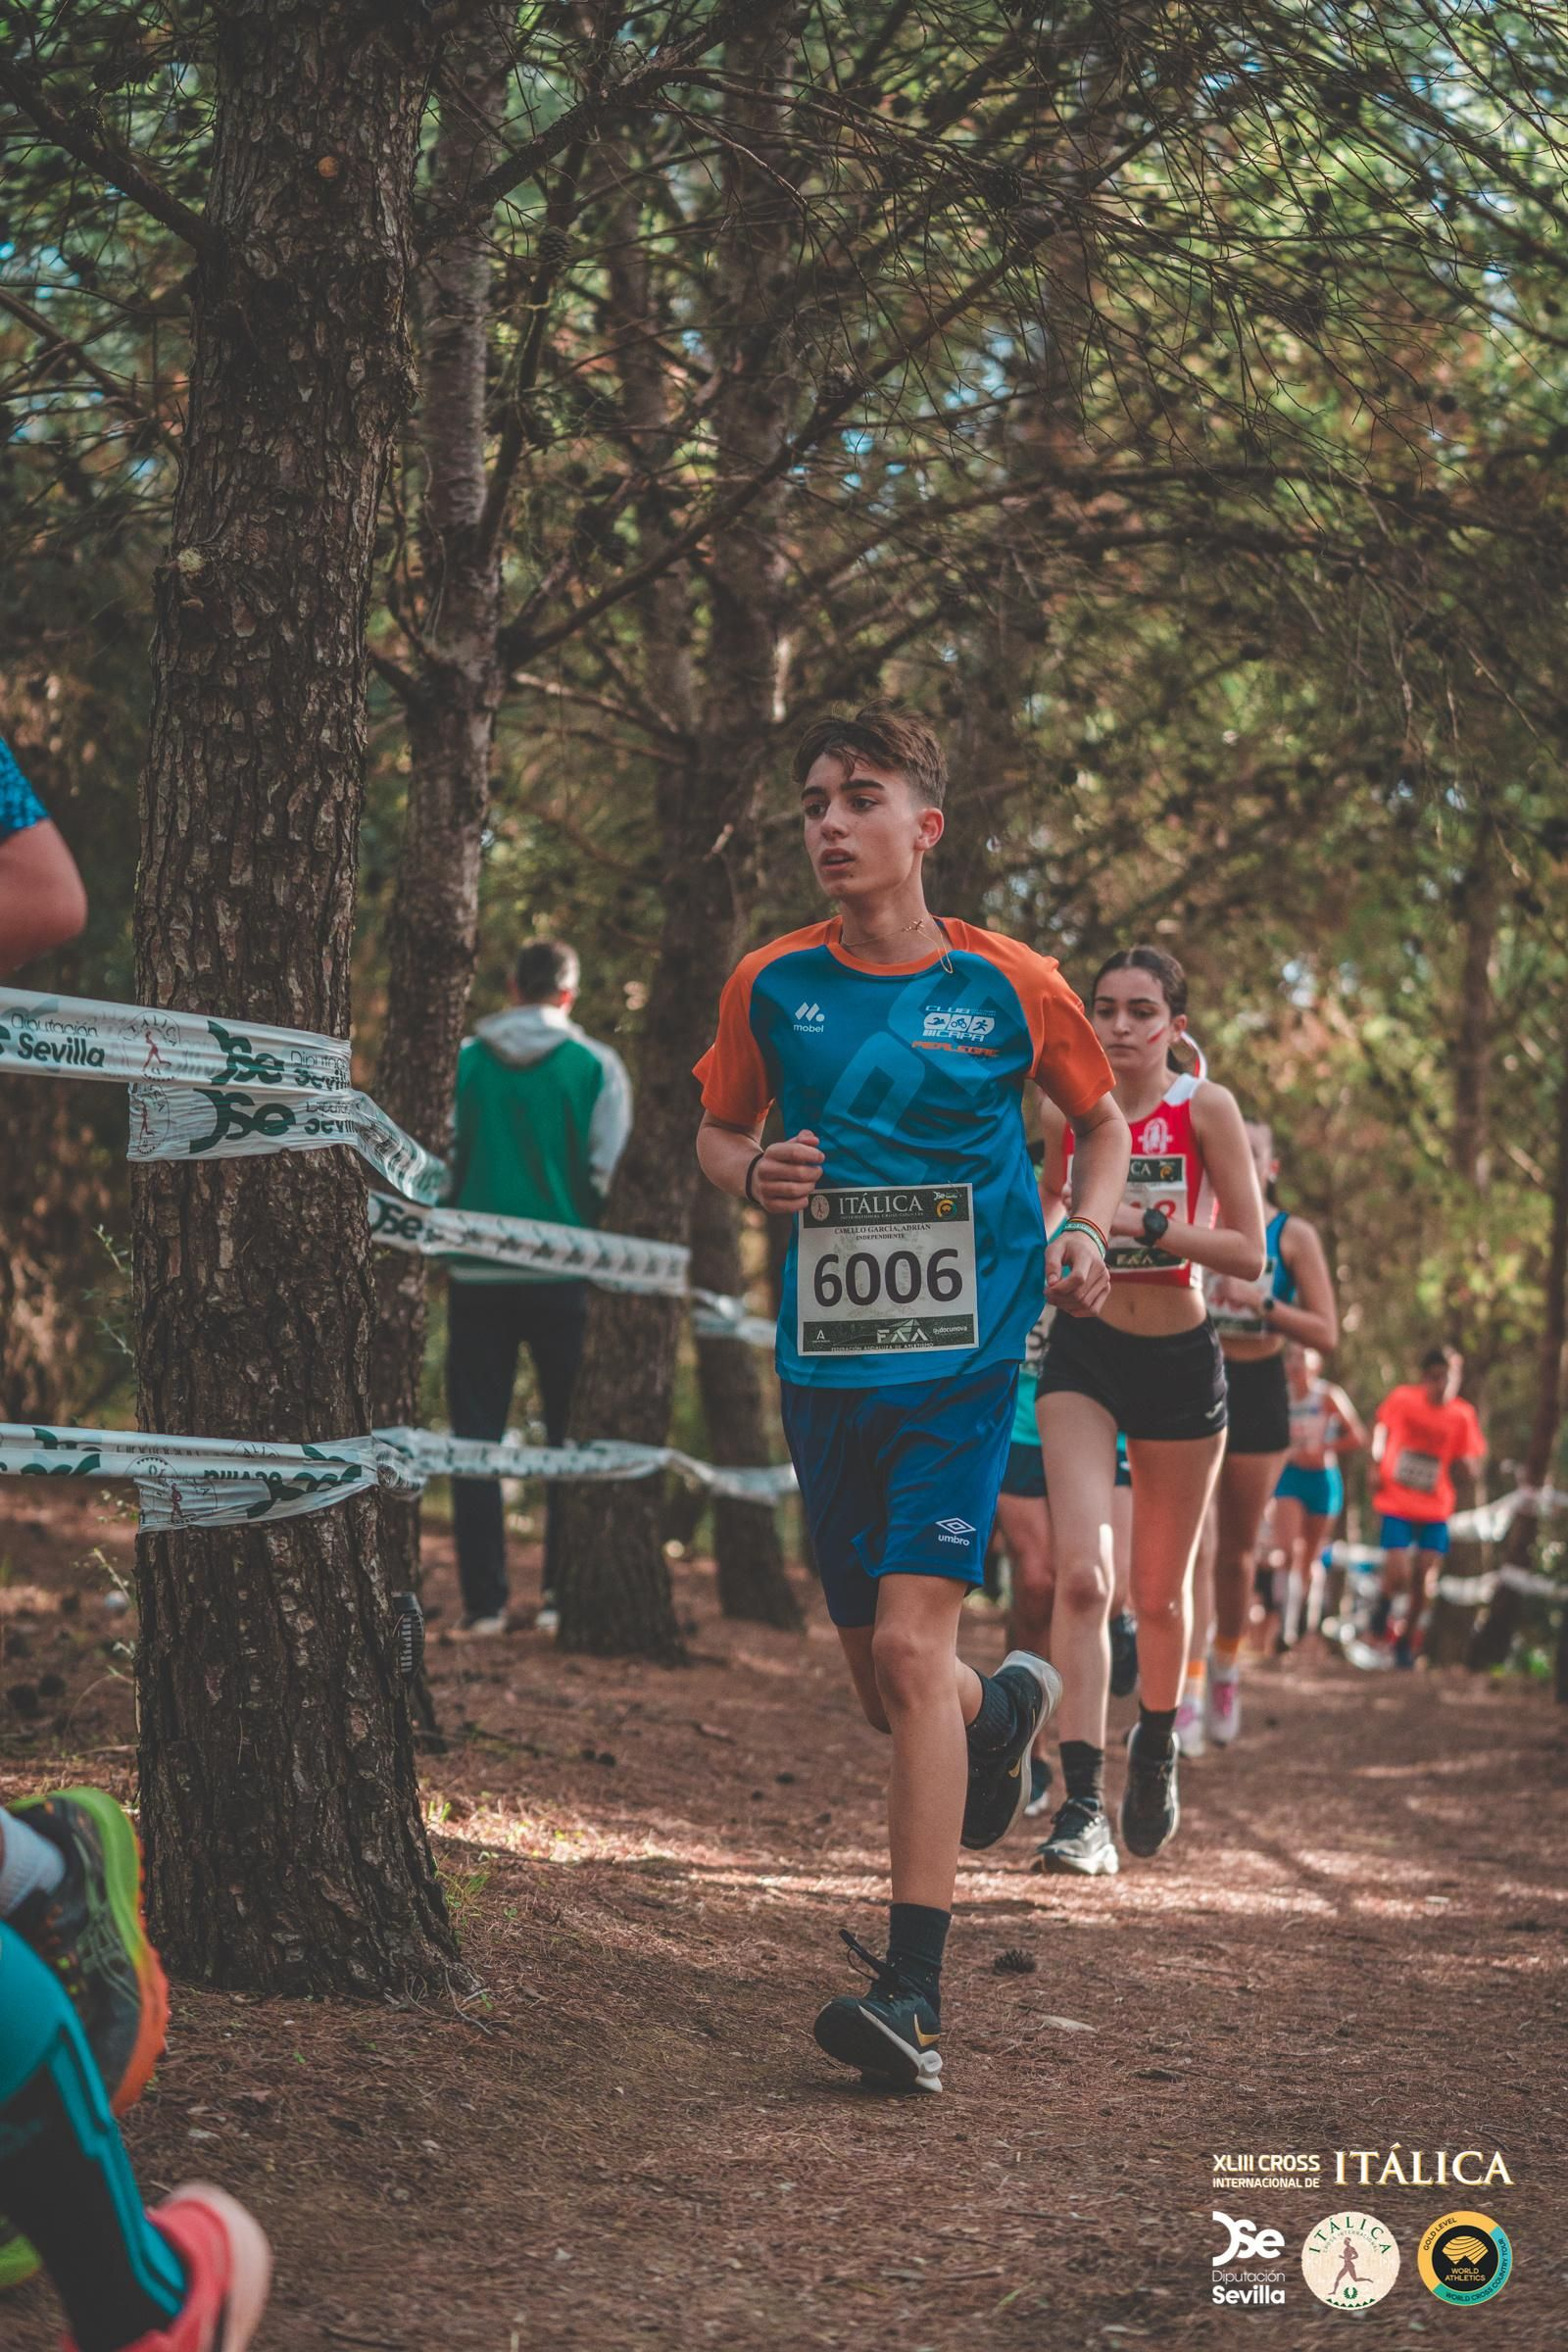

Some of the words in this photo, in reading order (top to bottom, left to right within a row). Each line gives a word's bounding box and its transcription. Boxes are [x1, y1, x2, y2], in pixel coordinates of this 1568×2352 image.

[793, 1024, 824, 1033] mobel
[17, 1032, 105, 1067] Sevilla
[839, 1193, 923, 1214] ITÁLICA
[814, 1248, 962, 1307] 6006
[938, 1534, 970, 1546] umbro
